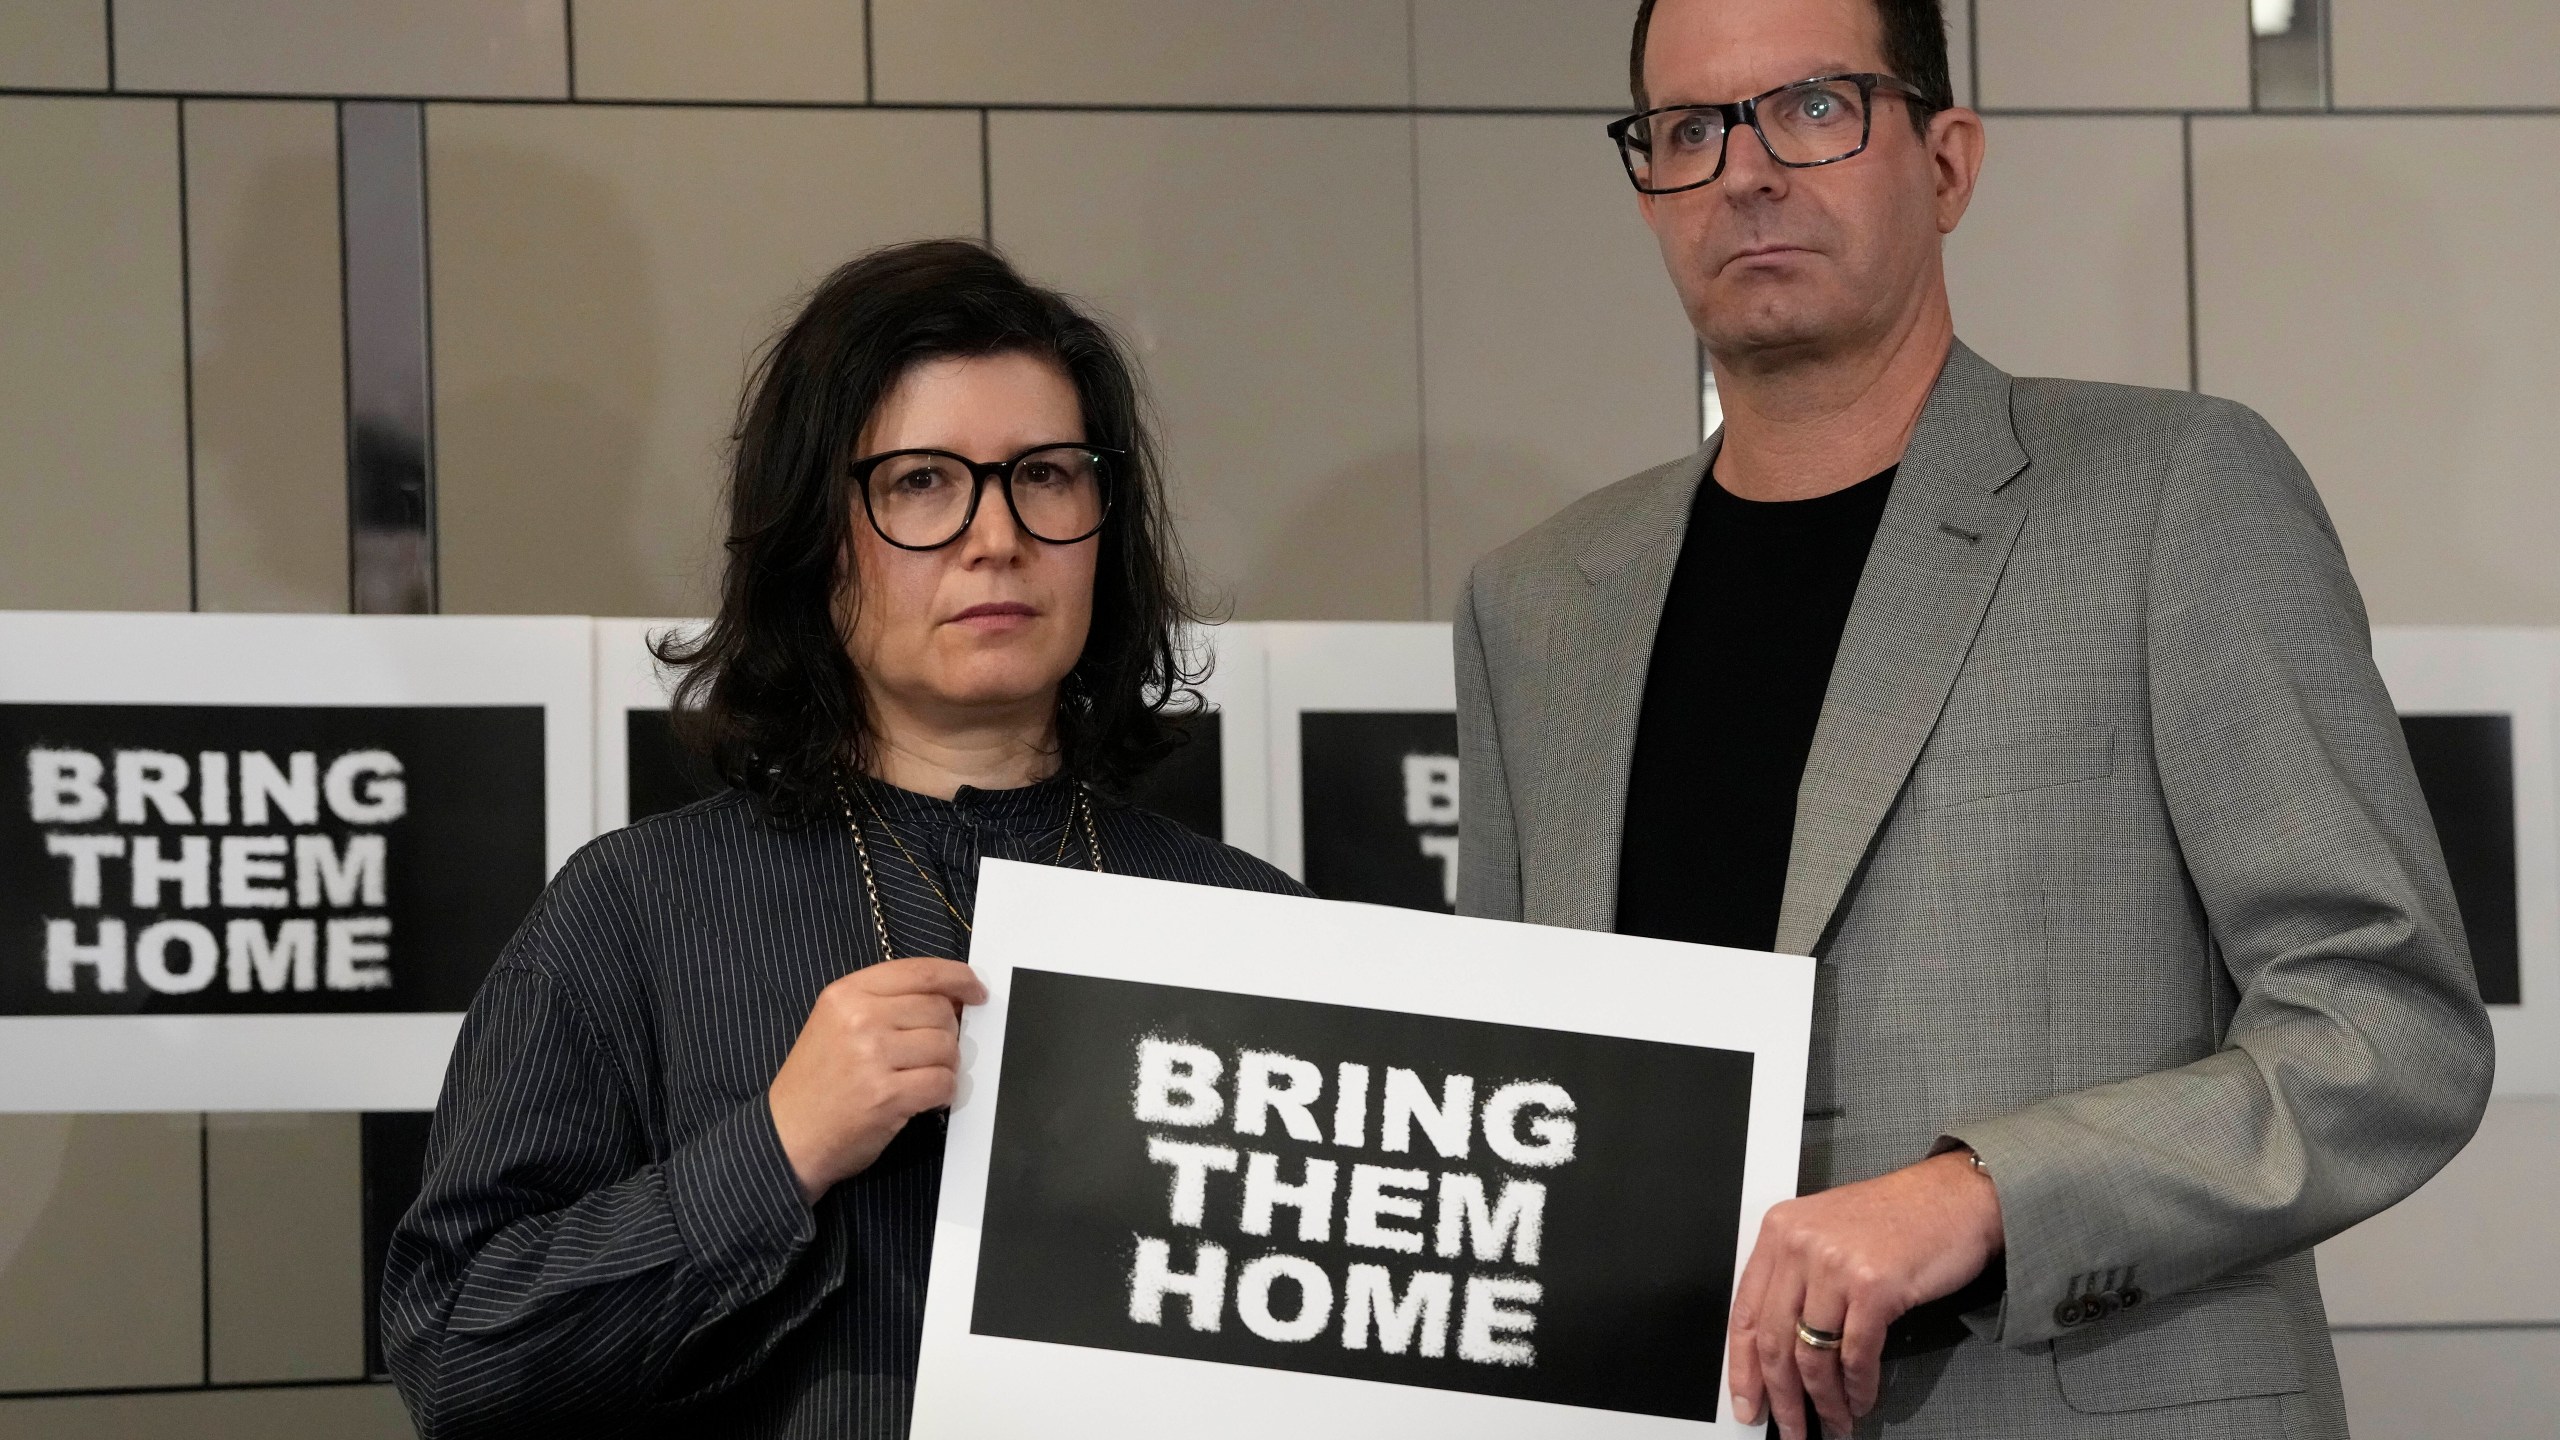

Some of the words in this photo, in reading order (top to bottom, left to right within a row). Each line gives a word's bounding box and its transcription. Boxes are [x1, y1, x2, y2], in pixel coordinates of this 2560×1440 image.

[27, 748, 406, 825] BRING
[46, 834, 386, 907] THEM
[45, 917, 391, 993] HOME
[1131, 1033, 1577, 1168] BRING
[1146, 1133, 1547, 1265] THEM
[1127, 1233, 1543, 1366] HOME
